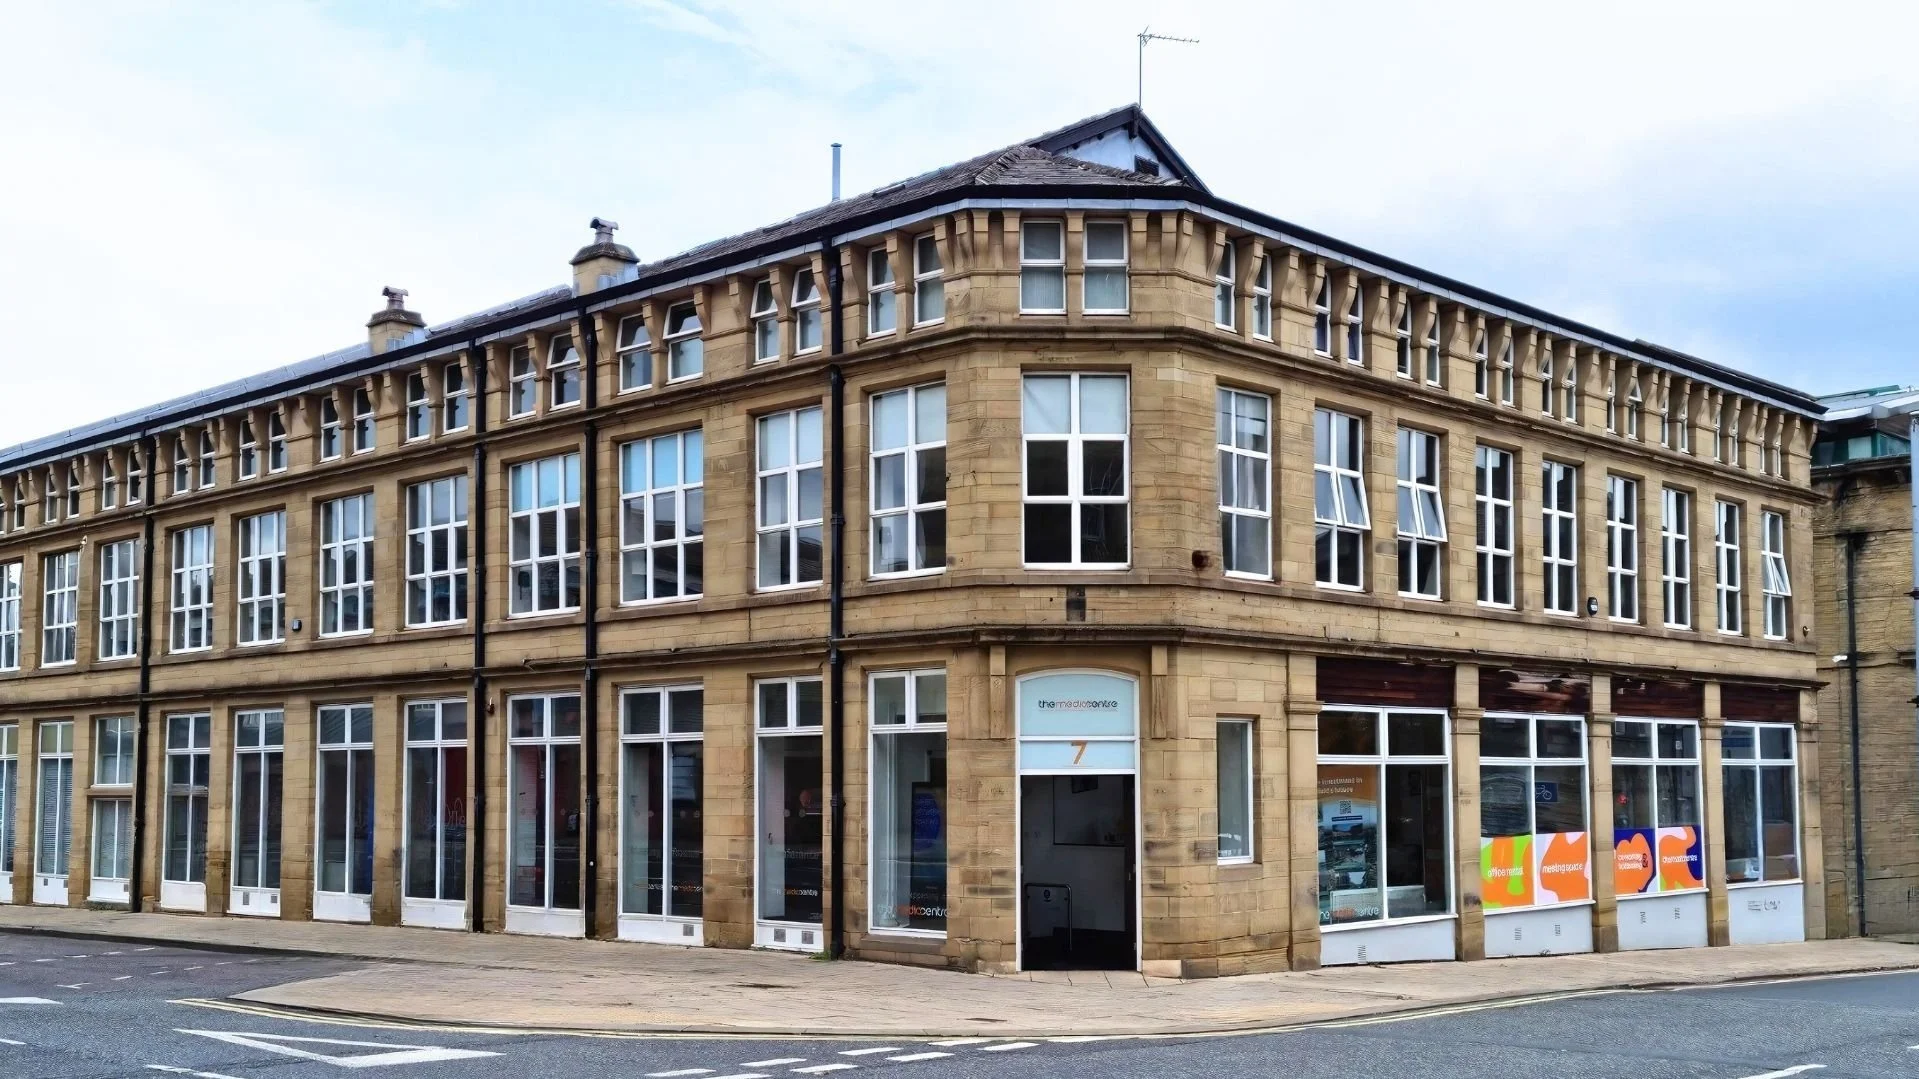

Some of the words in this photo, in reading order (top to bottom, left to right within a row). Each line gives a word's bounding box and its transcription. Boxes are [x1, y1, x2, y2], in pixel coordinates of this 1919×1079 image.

[1038, 699, 1118, 709] themediacentre
[1071, 740, 1088, 765] 7
[1487, 865, 1506, 878] office
[1542, 863, 1565, 874] meeting
